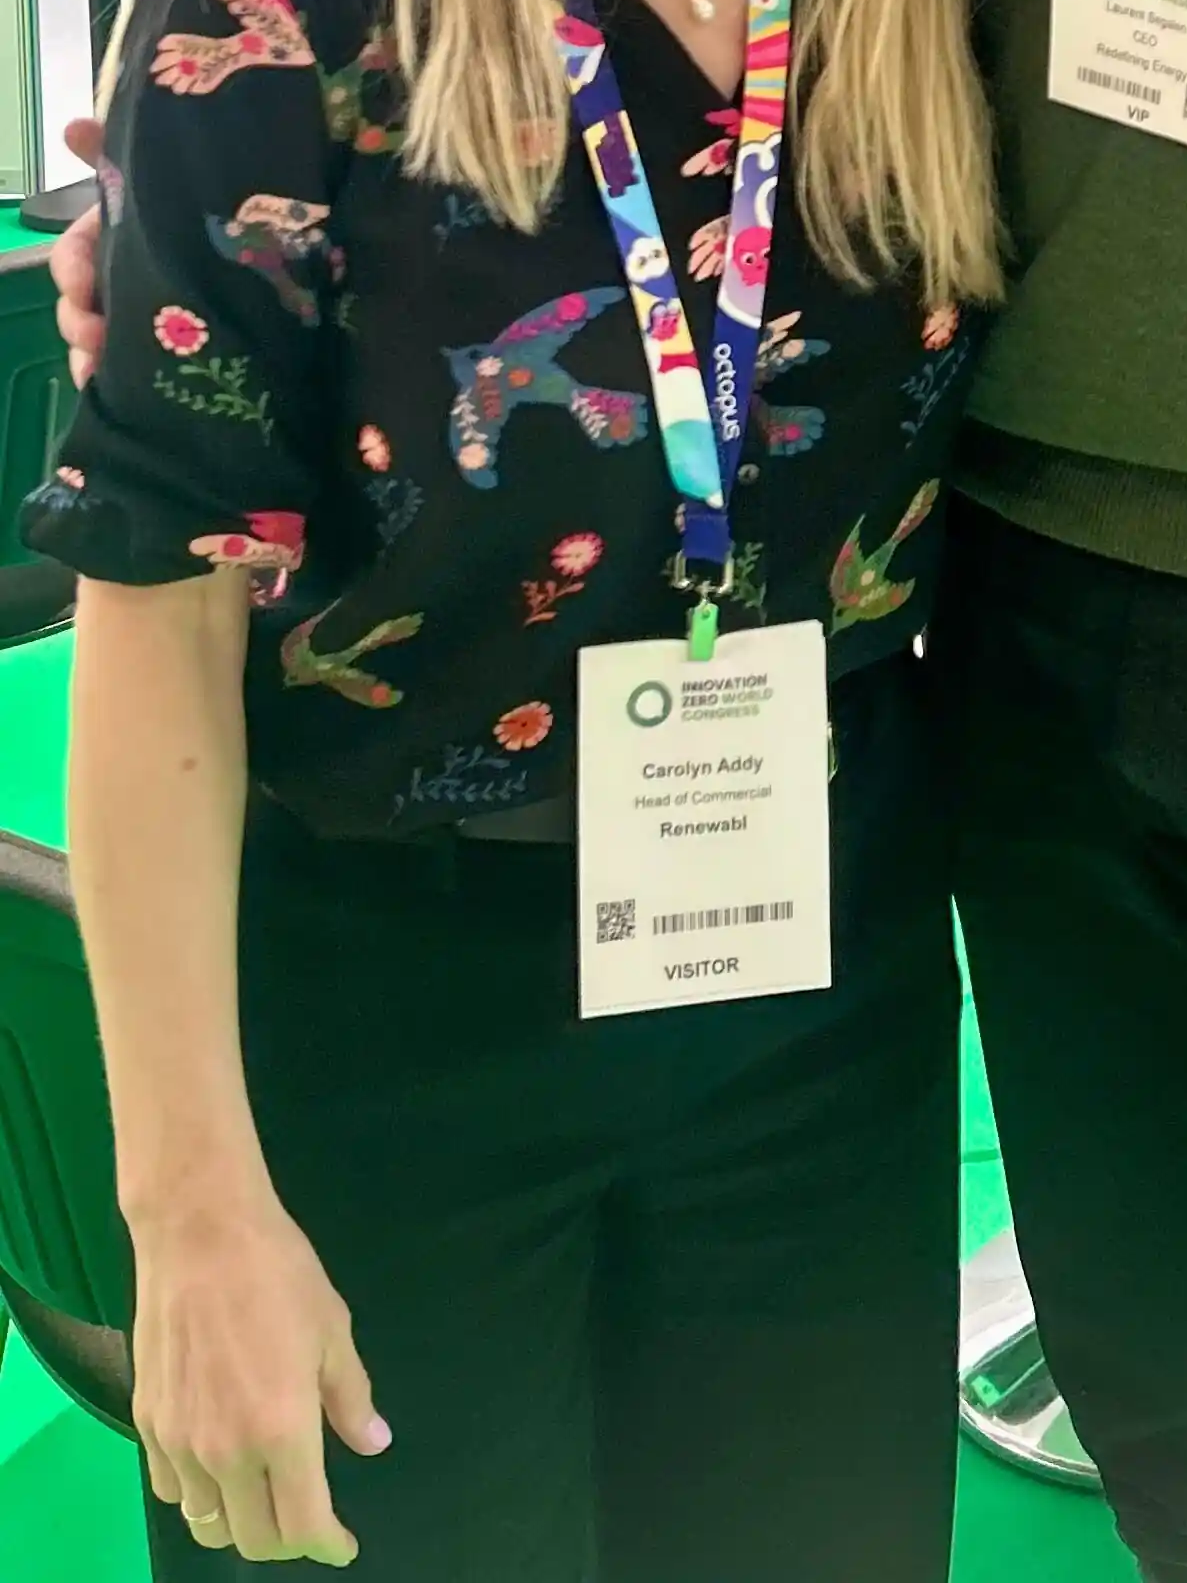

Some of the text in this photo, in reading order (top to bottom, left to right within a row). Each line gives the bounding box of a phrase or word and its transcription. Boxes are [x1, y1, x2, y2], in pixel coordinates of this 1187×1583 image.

[1105, 0, 1145, 20] Laurent
[1132, 29, 1158, 47] CEO
[1096, 42, 1187, 83] Redefining Energy
[1127, 104, 1149, 123] VIP
[712, 343, 740, 441] octopus
[682, 673, 768, 693] INNOVATION
[681, 687, 774, 708] ZERO WORLD
[681, 703, 761, 722] CONGRESS
[642, 754, 764, 780] Carolyn Addy
[634, 784, 772, 810] Head of Commercial
[659, 815, 748, 838] Renewabl
[664, 956, 741, 981] VISITOR
